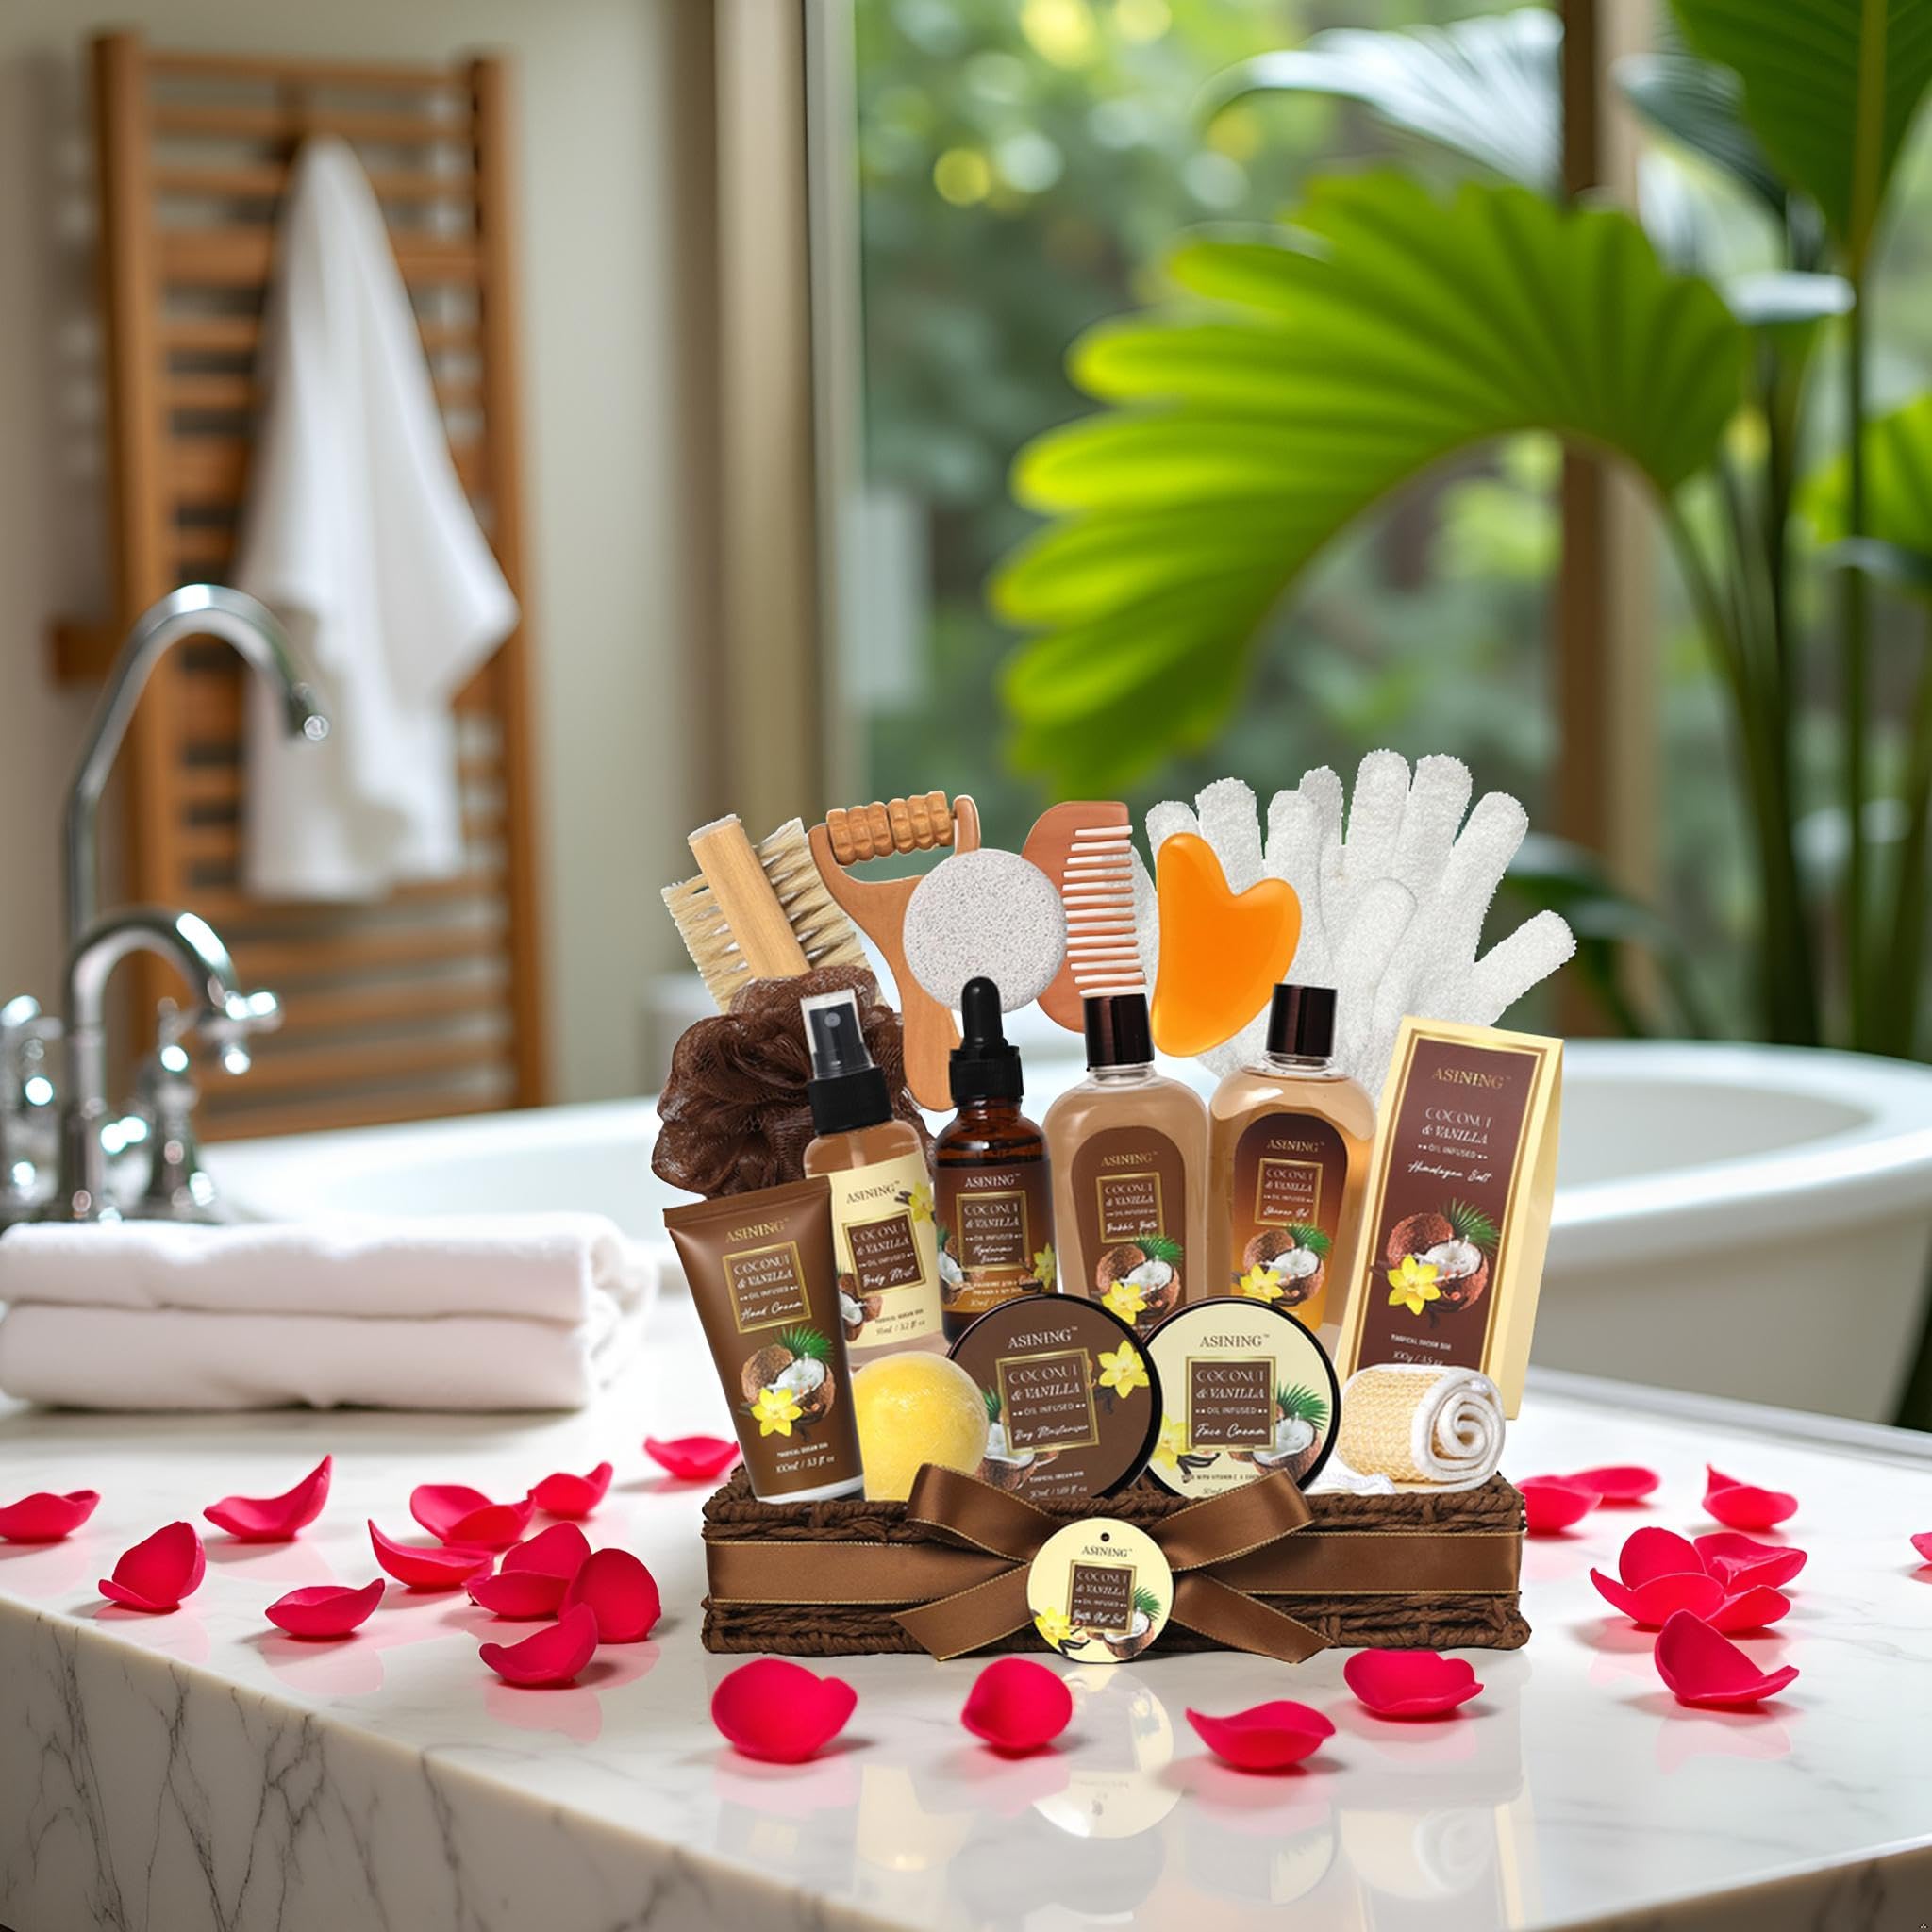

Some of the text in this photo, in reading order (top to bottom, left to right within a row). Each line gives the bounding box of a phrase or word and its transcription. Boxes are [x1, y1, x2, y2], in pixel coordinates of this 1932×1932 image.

[1425, 1107, 1491, 1128] COCONUT
[1435, 1125, 1488, 1145] VANILLA
[1274, 1181, 1313, 1192] VANILLA
[1115, 1195, 1154, 1206] VANILLA
[974, 1216, 1019, 1228] VANILLA
[865, 1237, 910, 1254] VANILLA
[747, 1269, 793, 1286] VANILLA
[741, 1301, 804, 1321] Hand Cream
[1008, 1364, 1077, 1385] COCONUT
[1195, 1369, 1264, 1383] COCONUT
[1024, 1382, 1080, 1399] VANILLA
[1209, 1388, 1265, 1399] VANILLA
[1195, 1422, 1267, 1438] Face Cream
[1086, 1585, 1126, 1596] VANILLA
